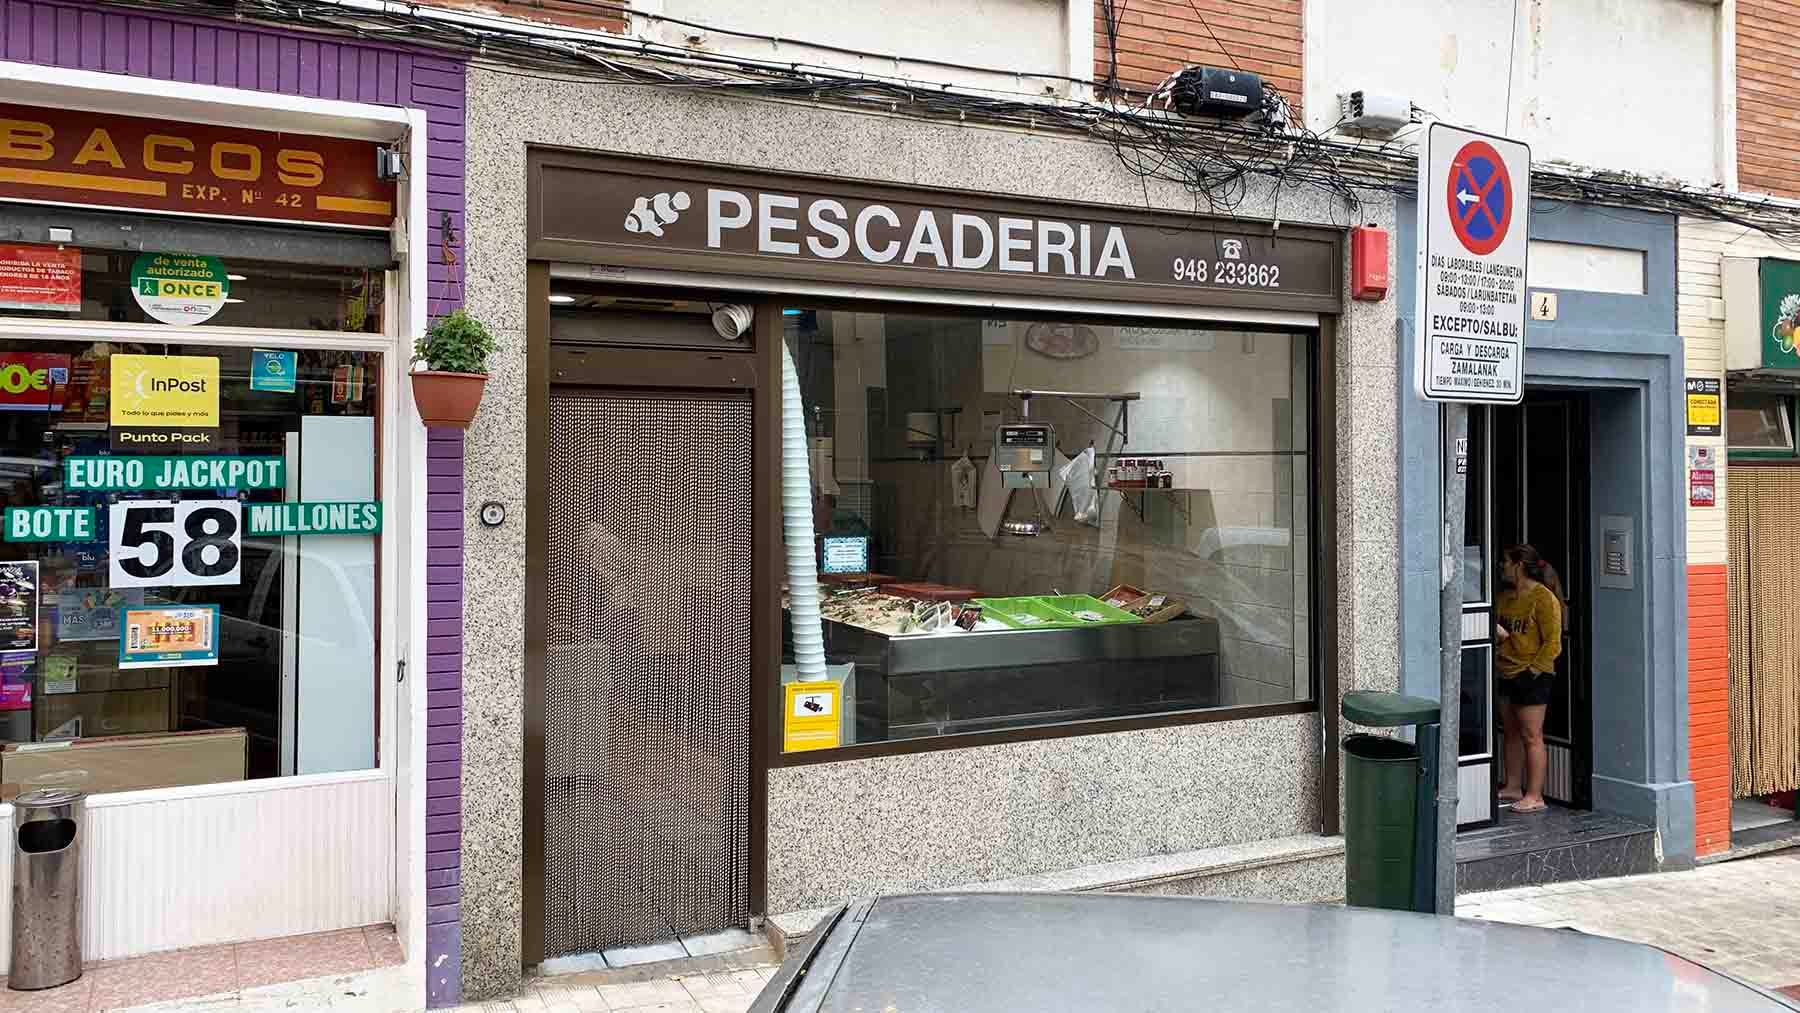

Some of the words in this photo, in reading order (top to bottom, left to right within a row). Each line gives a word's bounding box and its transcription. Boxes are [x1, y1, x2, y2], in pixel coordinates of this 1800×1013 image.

[182, 183, 227, 201] EXP.
[275, 192, 302, 208] 42
[707, 188, 1136, 280] PESCADERIA
[154, 256, 170, 266] de
[174, 258, 208, 269] venta
[147, 265, 214, 278] autorizado
[1174, 257, 1208, 282] 948
[1214, 261, 1280, 287] 233862
[163, 283, 217, 297] ONCE
[1540, 296, 1550, 316] 4
[1440, 342, 1463, 356] CARGA
[1467, 344, 1472, 357] Y
[1475, 345, 1510, 359] DESCARGA
[1451, 361, 1498, 376] ZAMALANAK
[151, 377, 207, 393] InPost
[120, 432, 168, 443] Punto
[171, 432, 210, 443] Pack
[69, 459, 144, 488] EURO
[155, 459, 281, 488] JACKPOT
[12, 508, 90, 538] BOTE
[118, 507, 240, 579] 58
[250, 503, 378, 532] MILLONES
